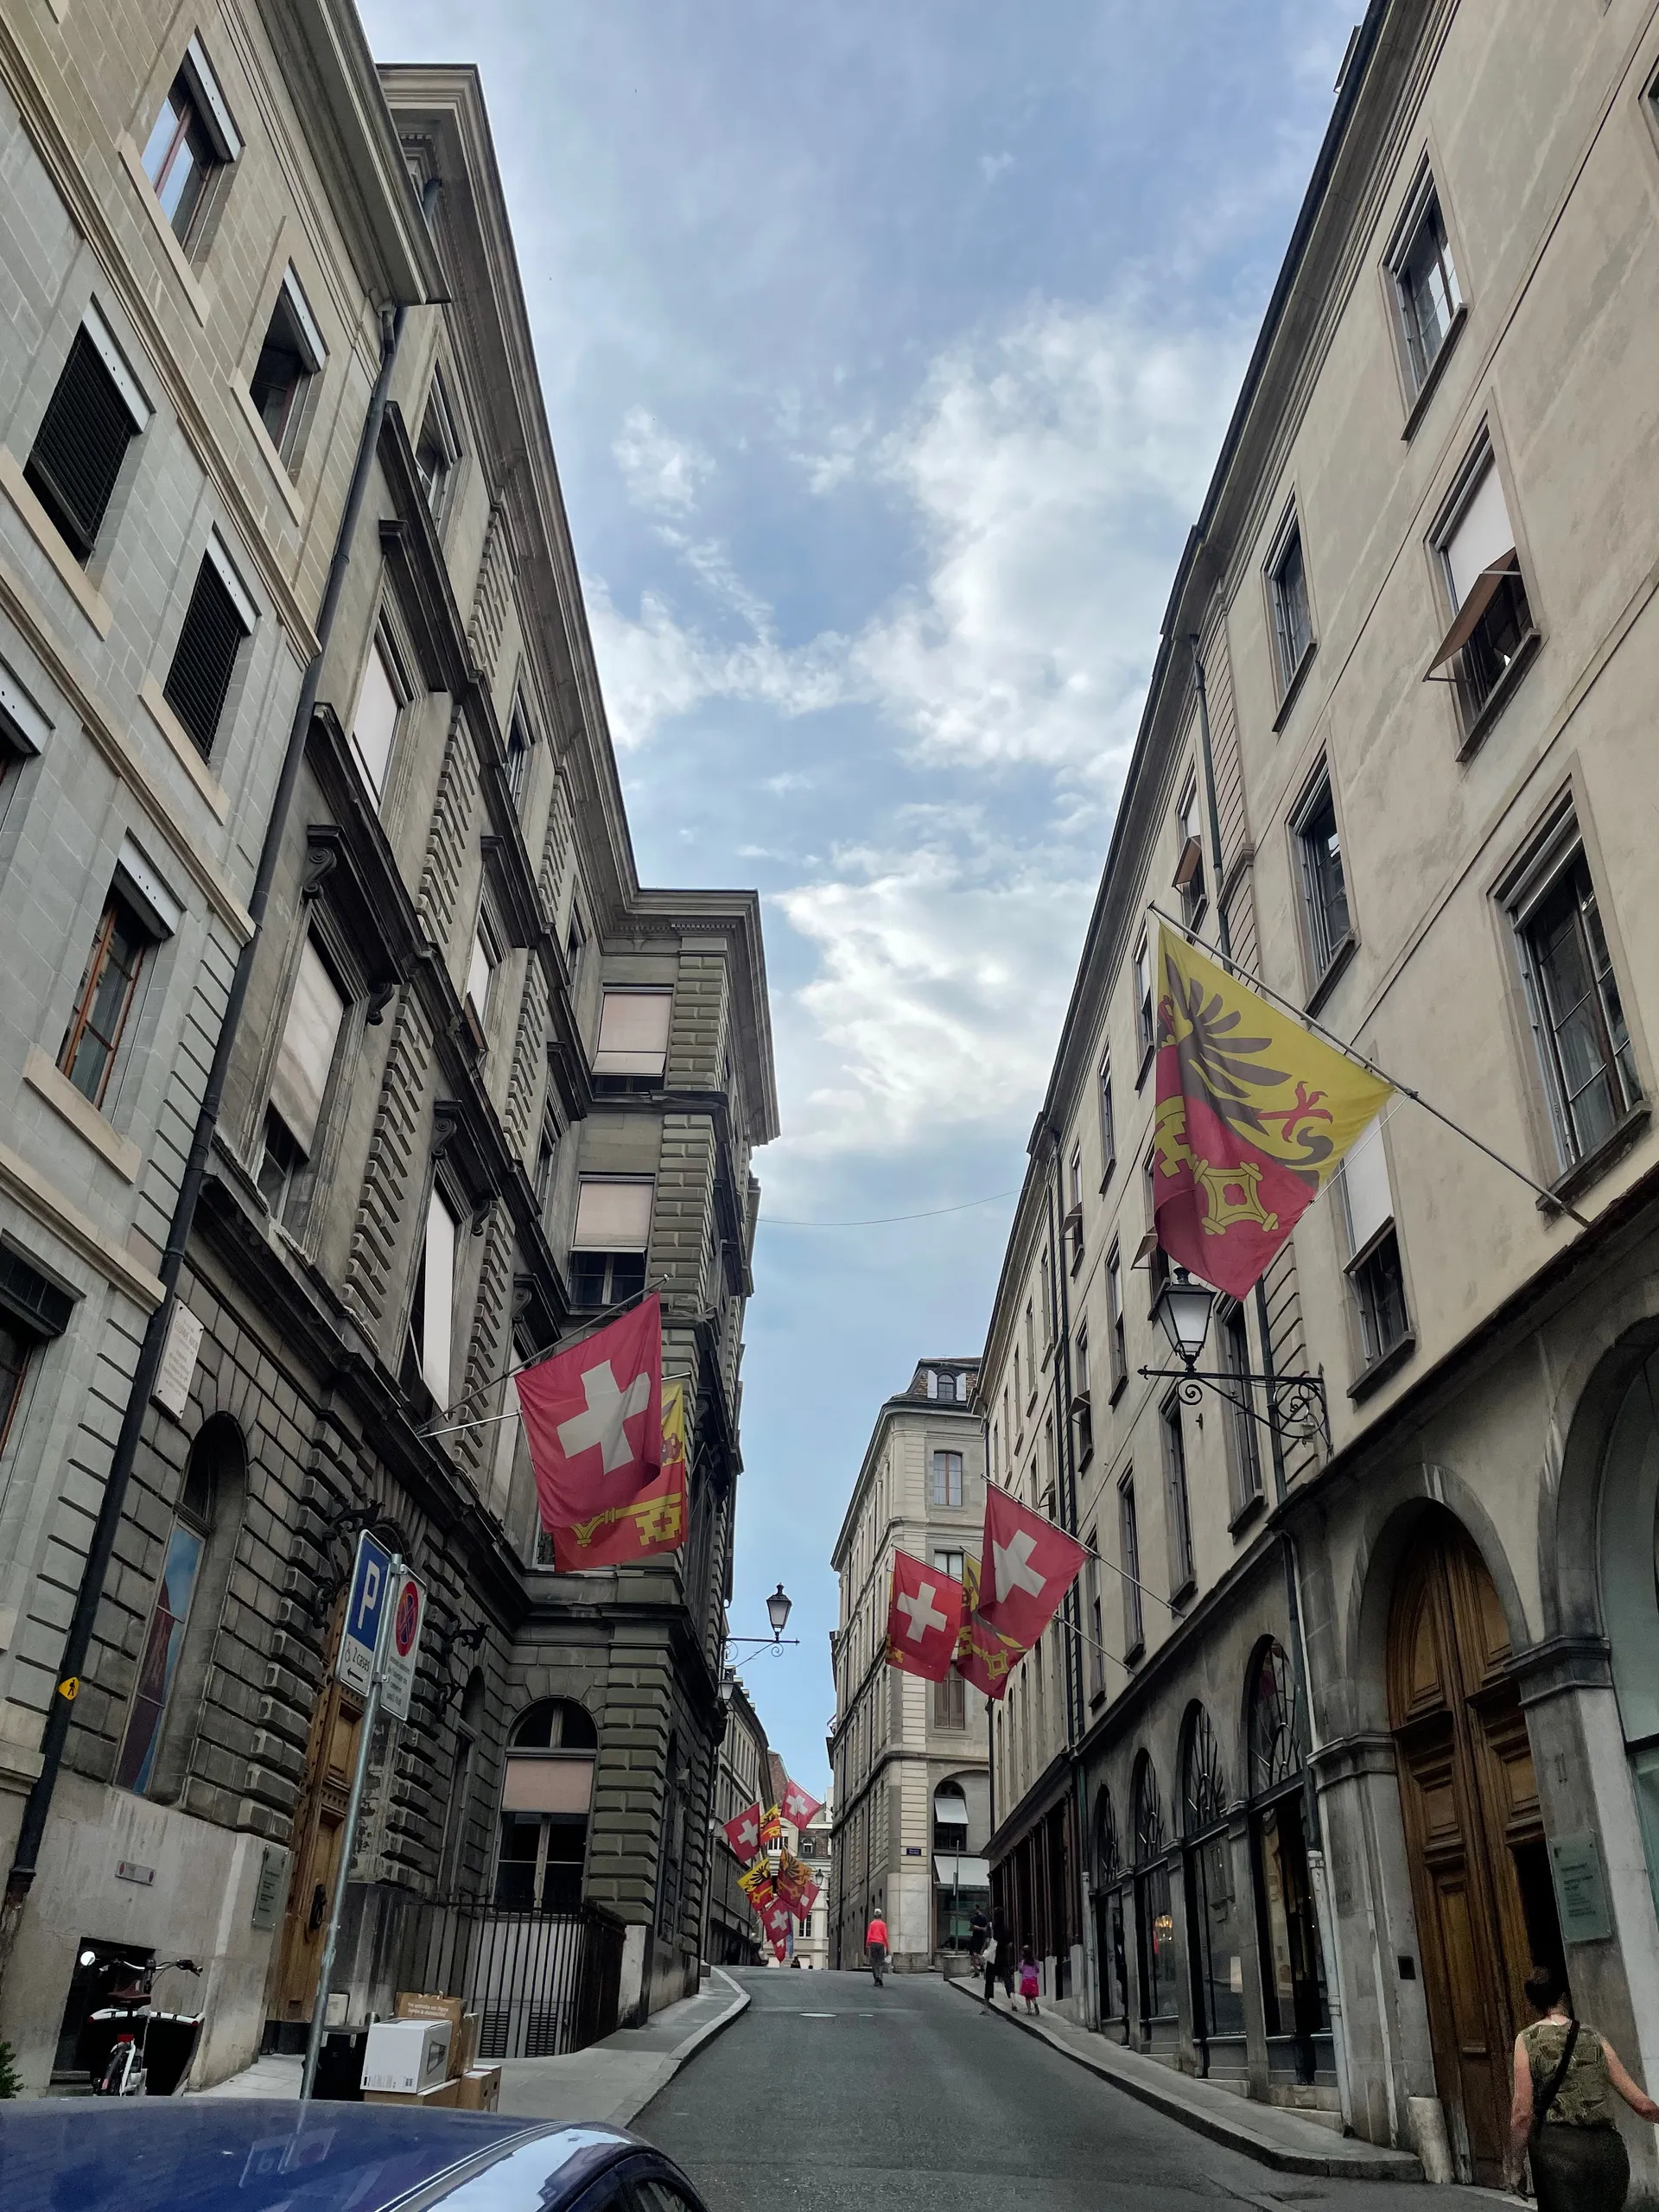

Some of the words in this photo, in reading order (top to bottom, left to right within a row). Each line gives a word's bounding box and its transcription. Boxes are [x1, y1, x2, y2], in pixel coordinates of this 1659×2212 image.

[357, 1559, 380, 1630] P
[352, 1646, 358, 1663] 2
[356, 1654, 371, 1673] cases
